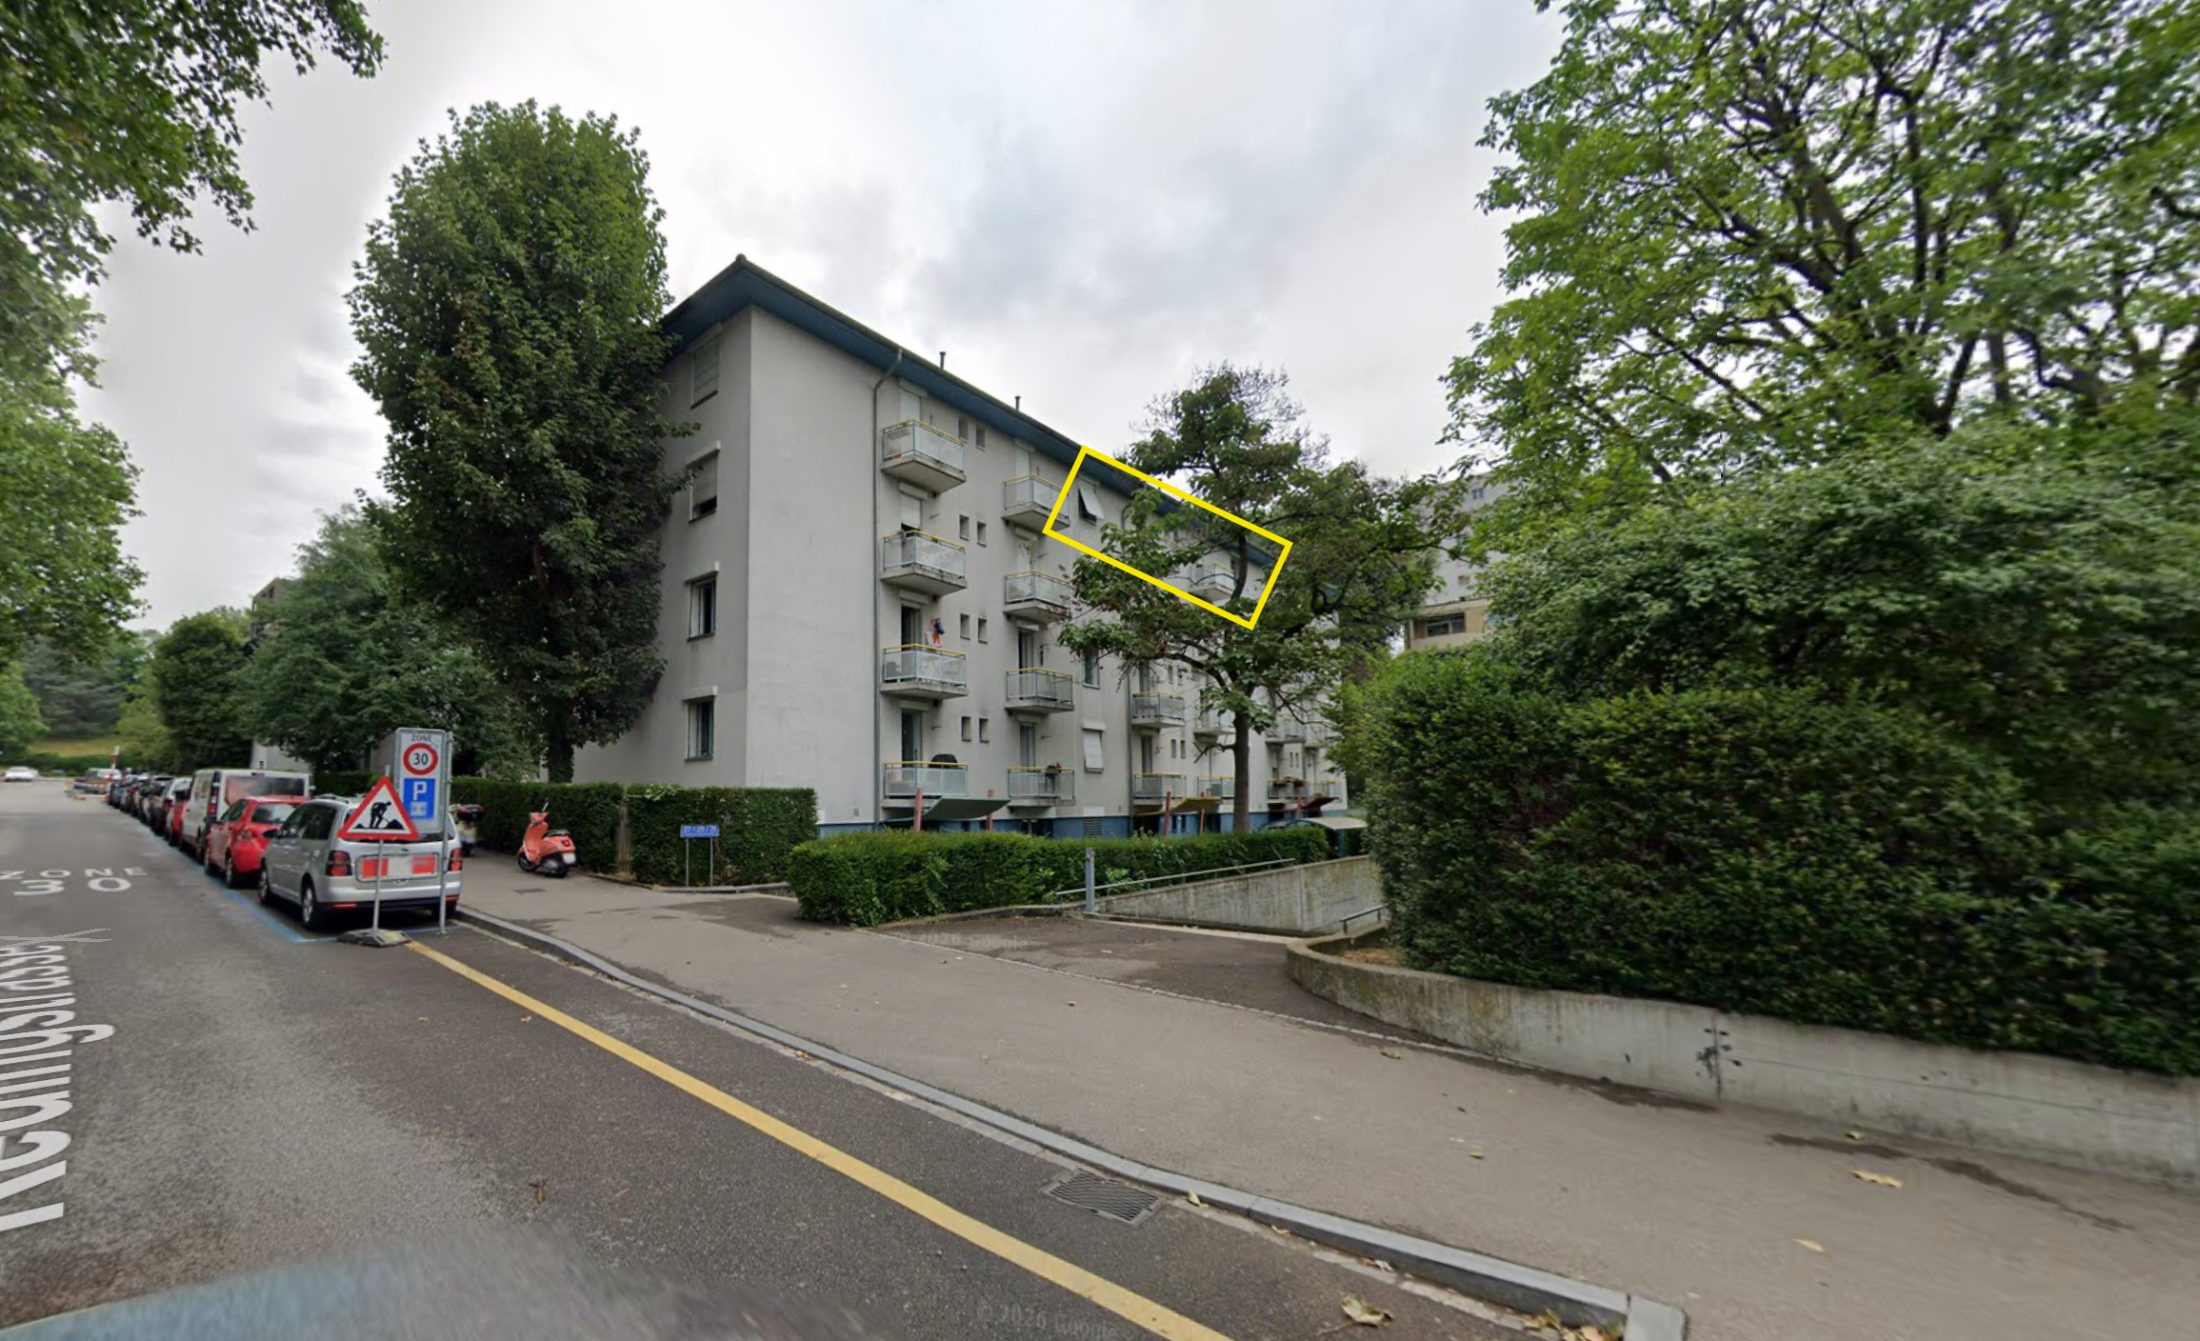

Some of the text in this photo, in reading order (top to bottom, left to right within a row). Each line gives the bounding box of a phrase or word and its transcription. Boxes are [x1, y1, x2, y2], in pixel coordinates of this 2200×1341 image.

[411, 734, 433, 742] ZONE
[413, 752, 429, 766] 30
[413, 781, 427, 801] P
[0, 867, 147, 880] ZONE
[13, 877, 131, 896] 30
